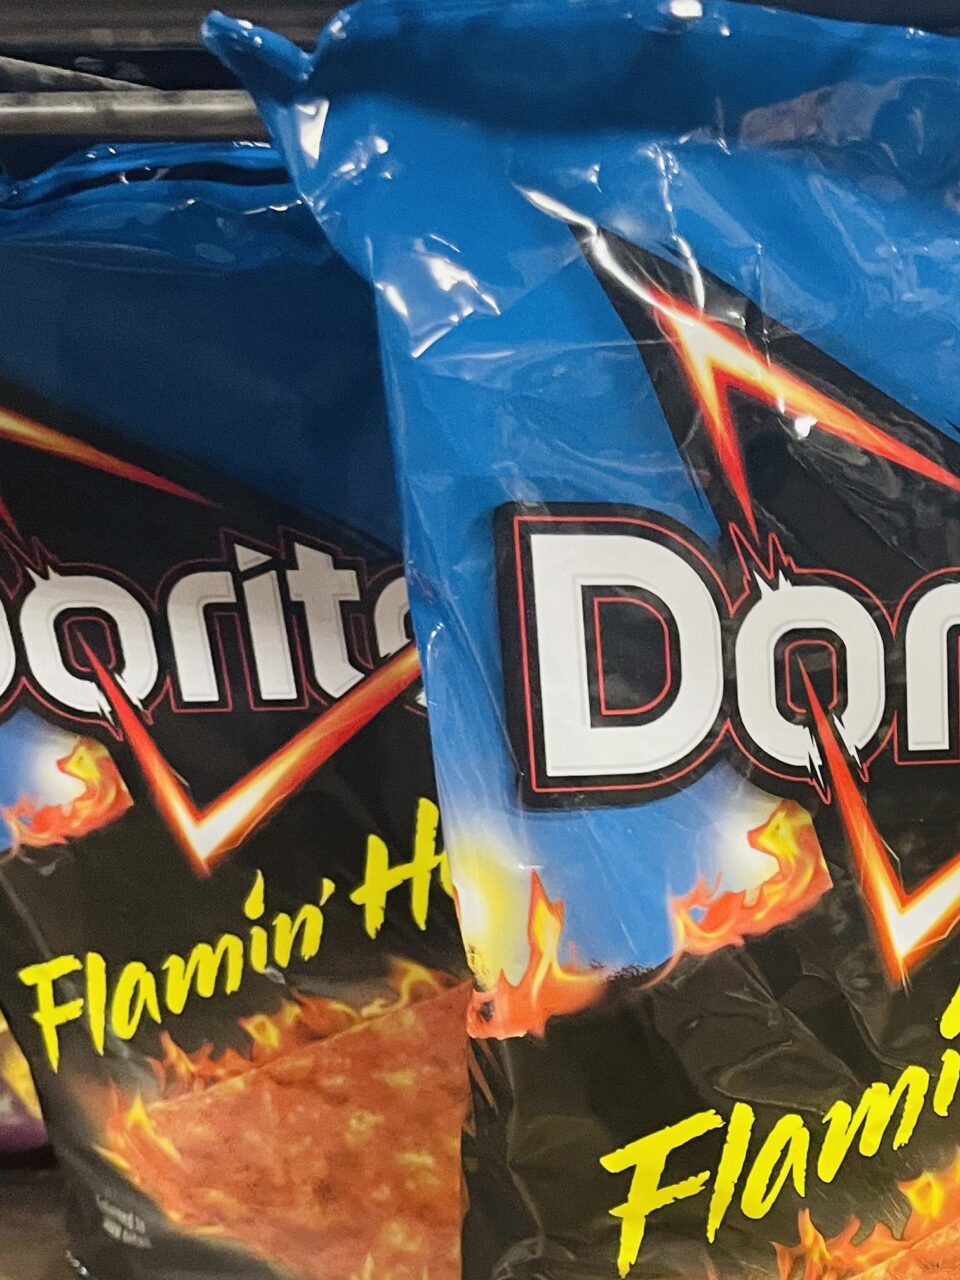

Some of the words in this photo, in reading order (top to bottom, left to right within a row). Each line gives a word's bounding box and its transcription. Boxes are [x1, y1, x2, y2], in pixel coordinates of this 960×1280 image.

[0, 542, 424, 724] orit
[18, 869, 336, 1074] Flamin'
[350, 797, 456, 940] H
